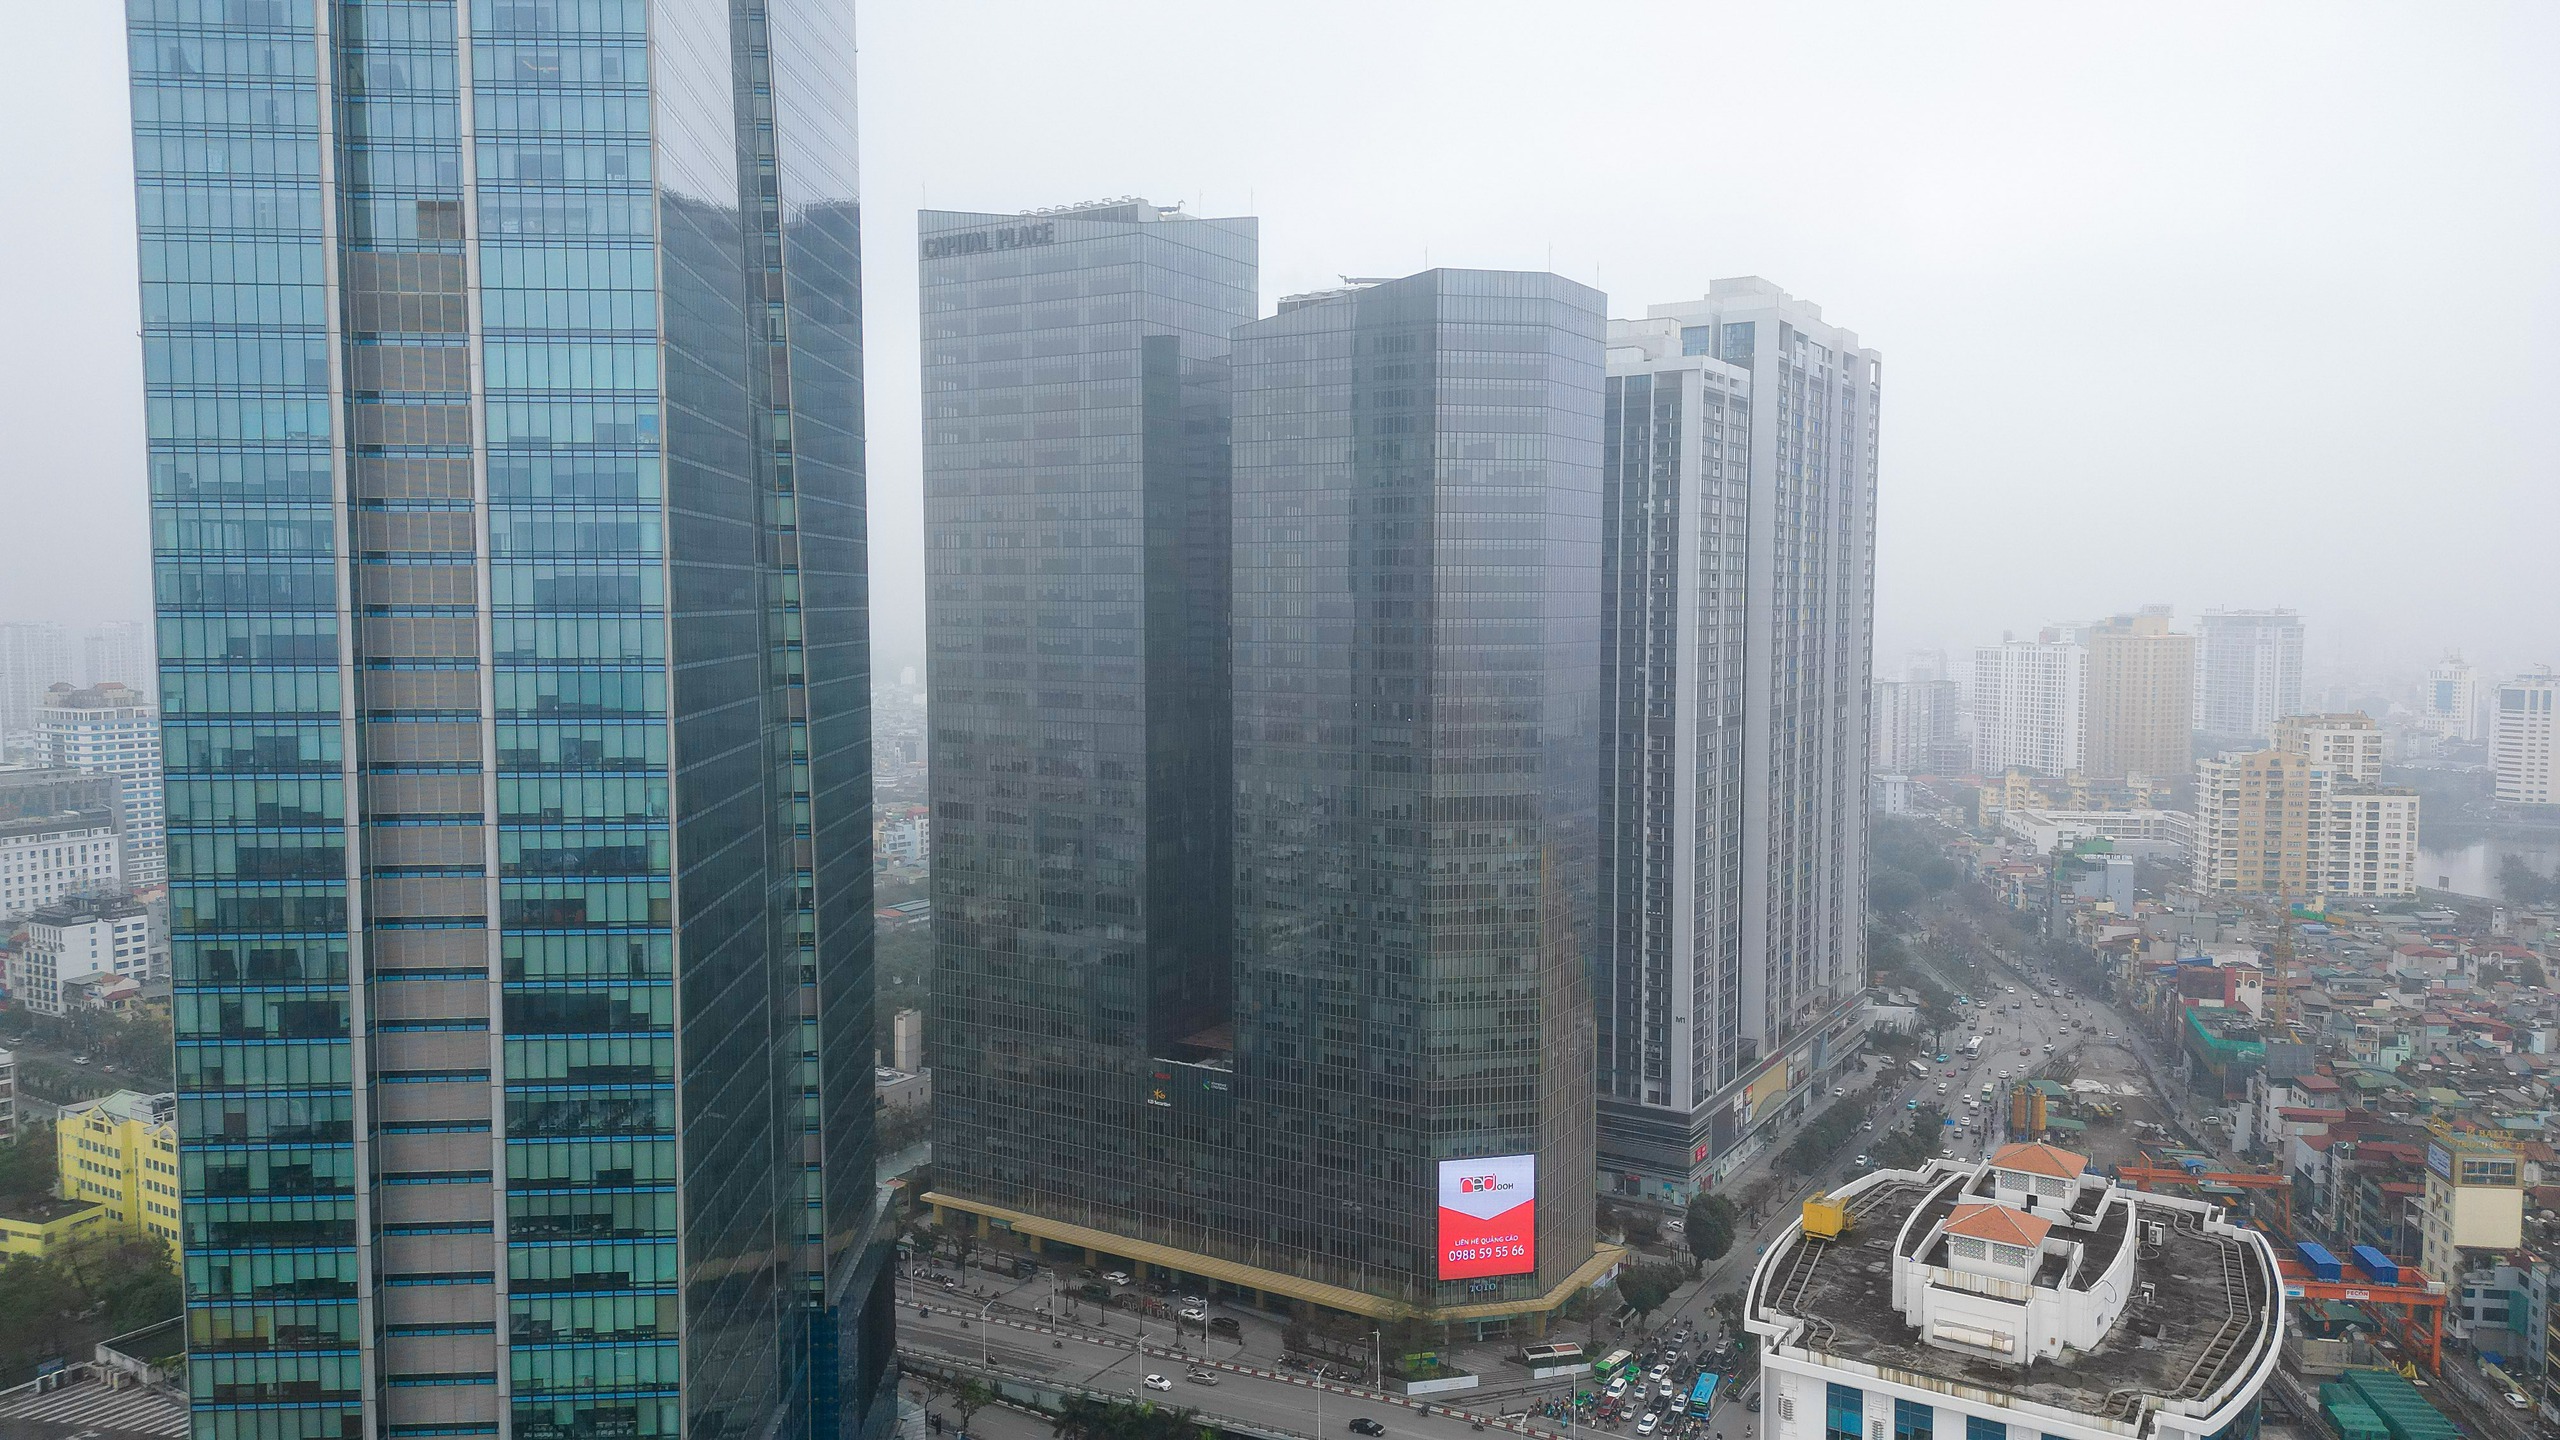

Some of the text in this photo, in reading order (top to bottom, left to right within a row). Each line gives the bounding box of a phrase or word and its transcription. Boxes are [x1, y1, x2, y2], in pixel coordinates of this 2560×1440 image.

[922, 222, 1054, 258] CAPITAL PLACE
[1675, 1016, 1686, 1024] M1
[1497, 1183, 1514, 1191] OOH
[1454, 1238, 1469, 1246] LIÊN
[1505, 1234, 1518, 1242] CÁO
[1448, 1244, 1525, 1262] 0988 59 55 66
[1470, 1283, 1496, 1292] TOTO
